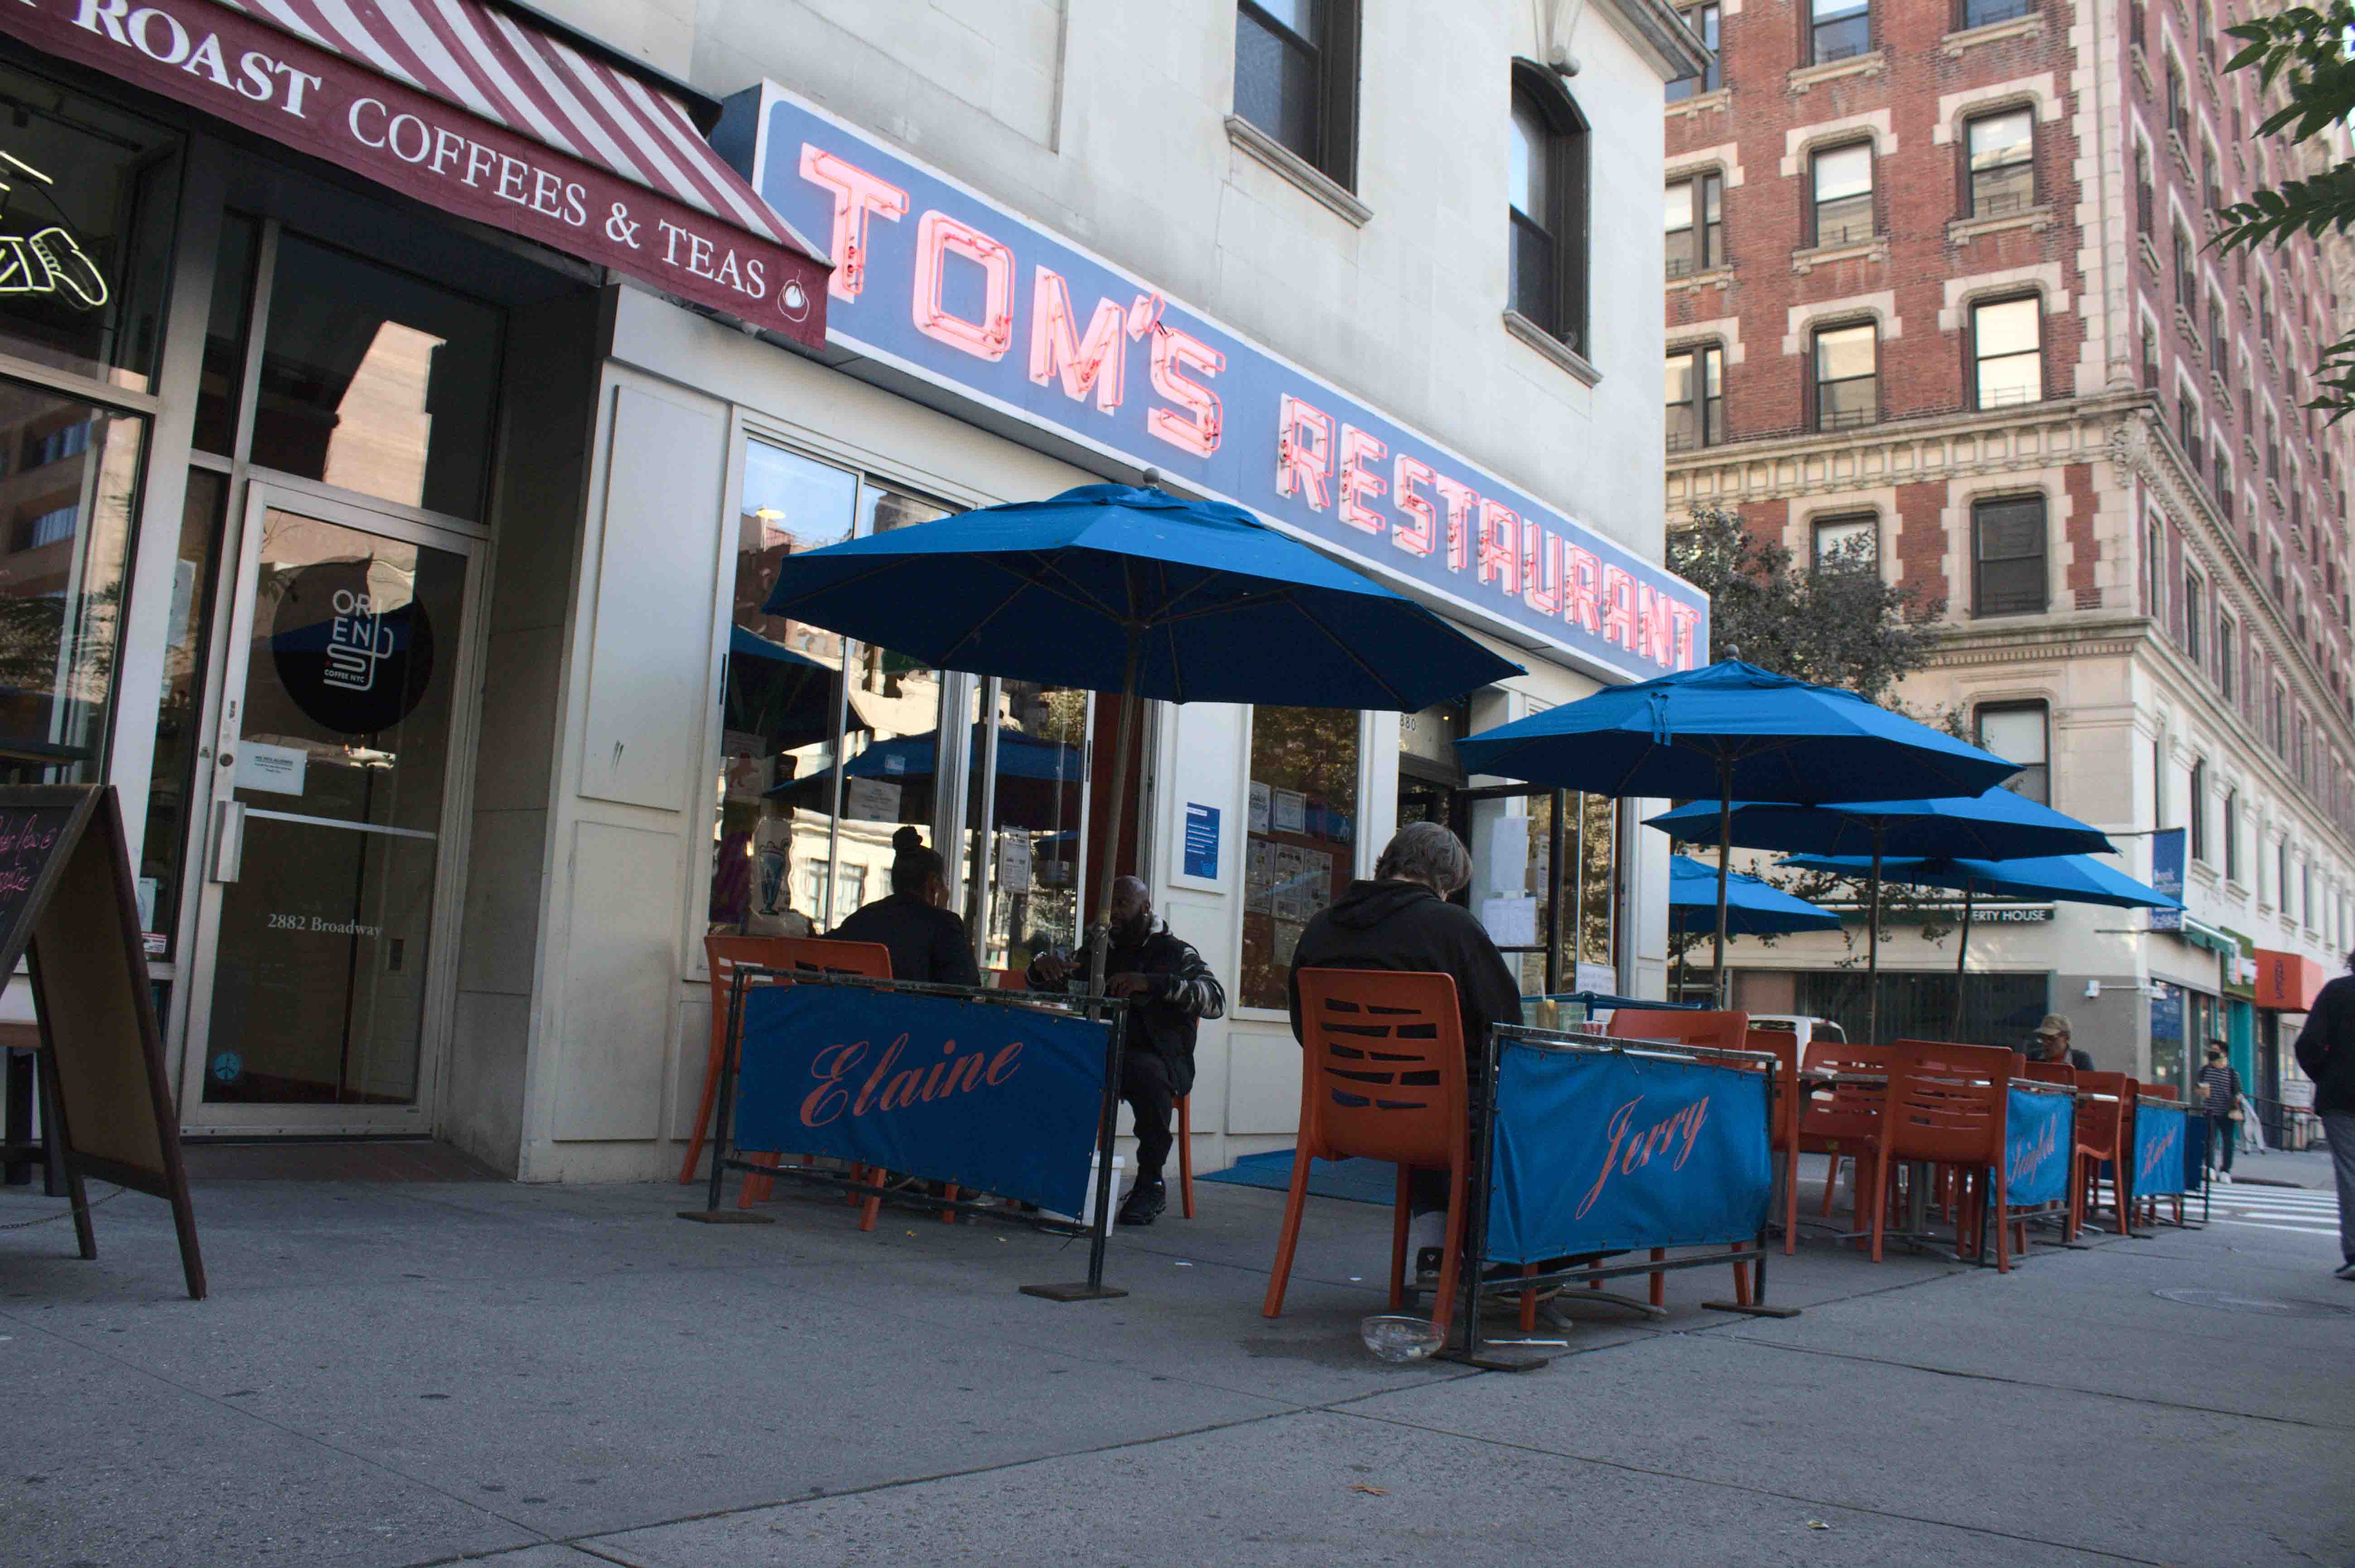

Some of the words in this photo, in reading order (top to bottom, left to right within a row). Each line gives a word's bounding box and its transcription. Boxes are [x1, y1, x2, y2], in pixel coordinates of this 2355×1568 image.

[70, 0, 322, 119] ROAST
[348, 97, 586, 226] COFFEES
[605, 202, 640, 250] &
[658, 219, 766, 299] TEAS
[799, 141, 1226, 459] TOM'S
[1275, 392, 1702, 671] RESTAURANT
[268, 913, 305, 930] 2882
[310, 916, 382, 940] Broadway
[2002, 910, 2045, 921] HOUSE
[800, 1032, 1024, 1128] Elaine
[1575, 1095, 1709, 1220] Jerry
